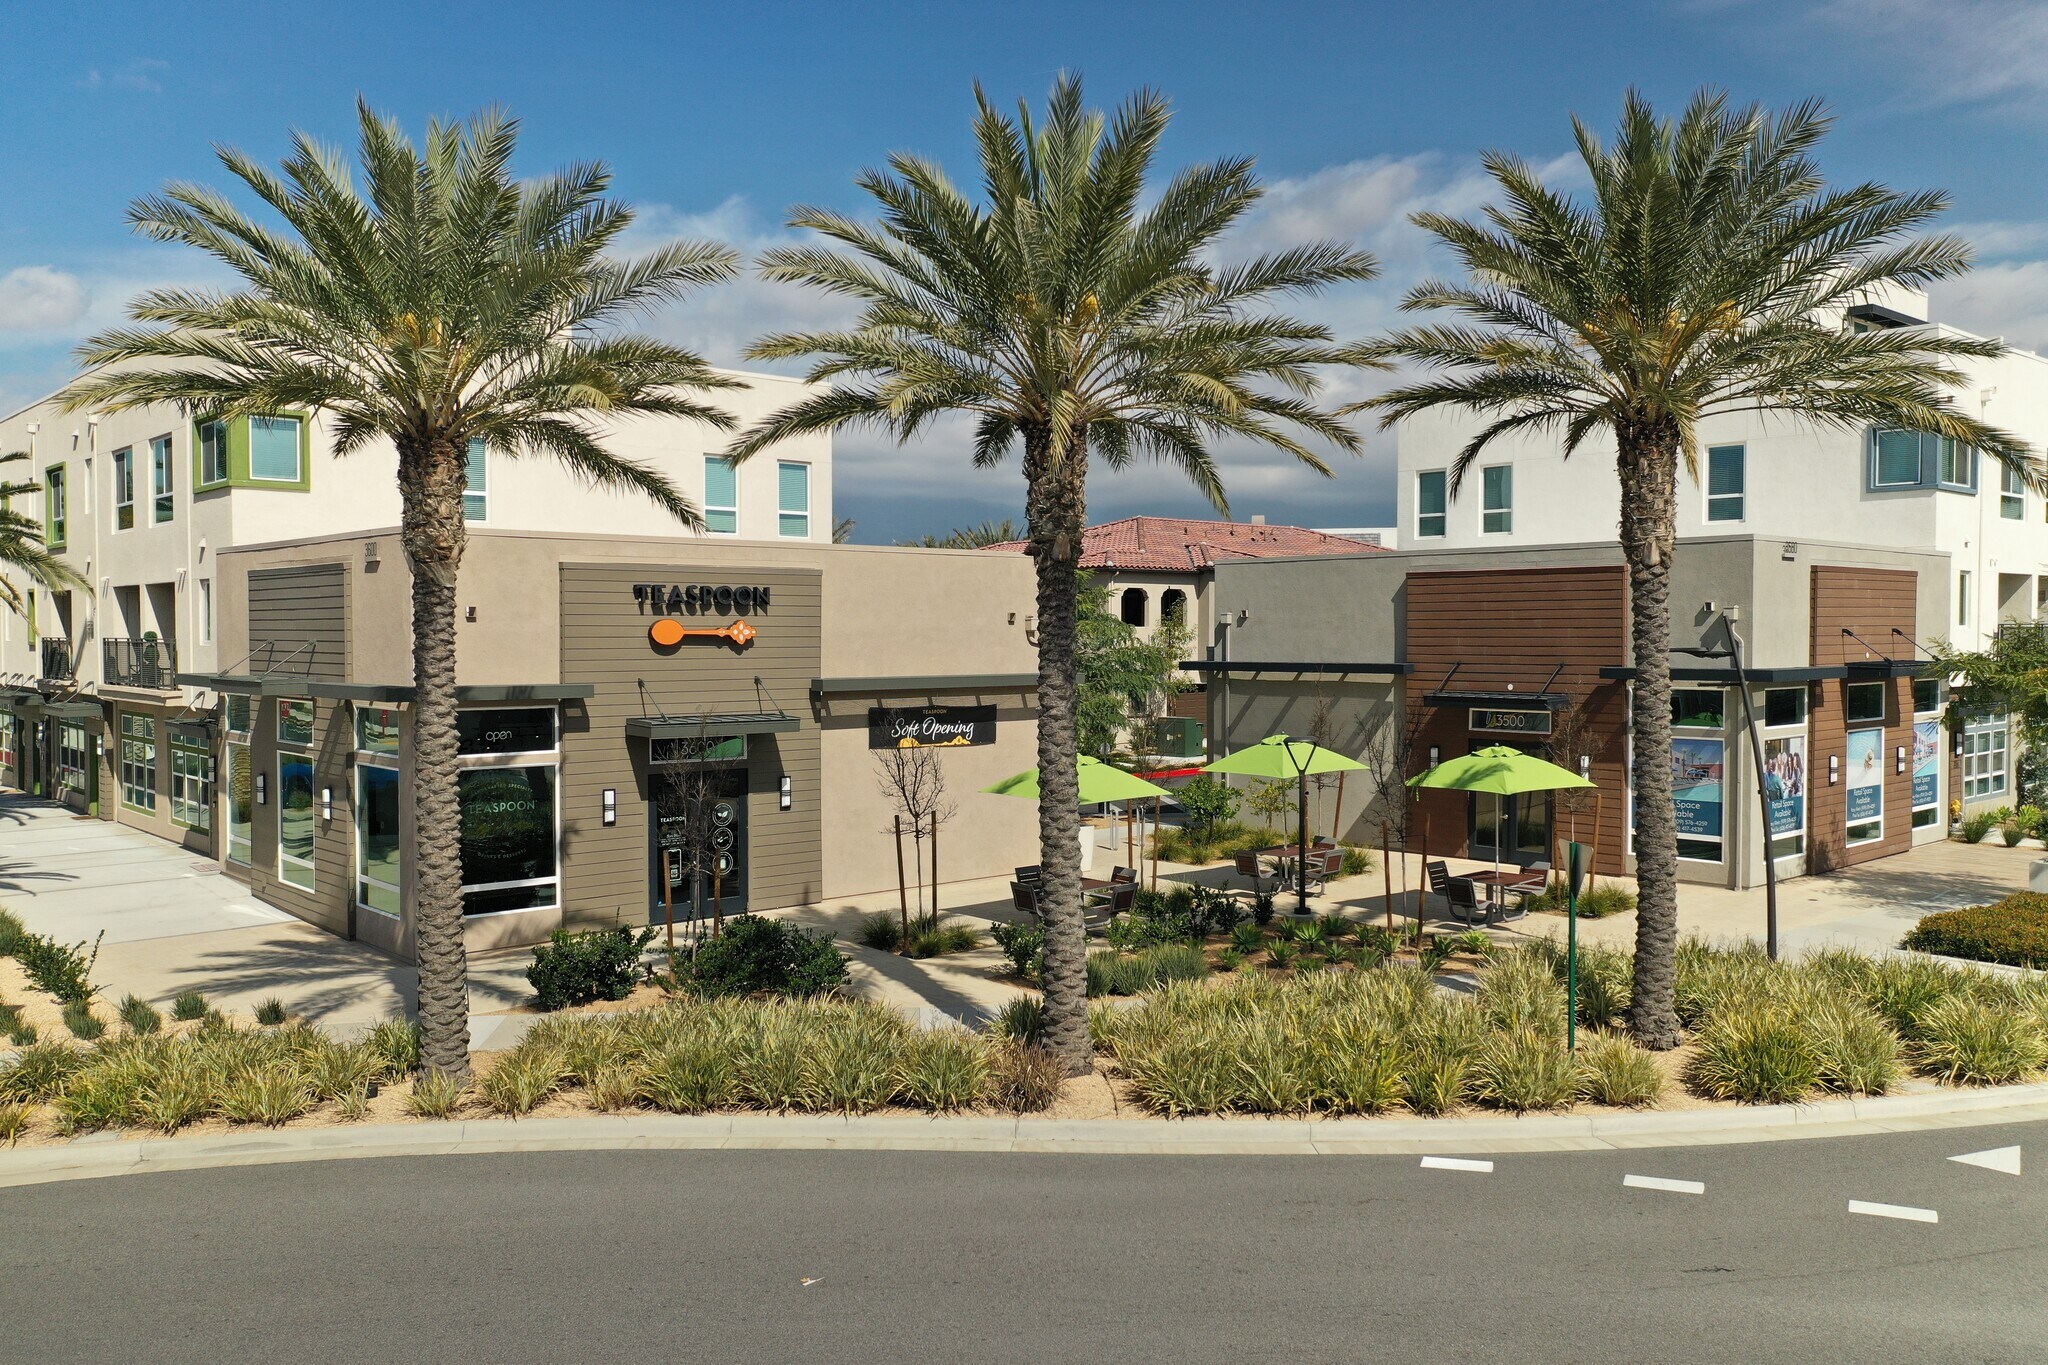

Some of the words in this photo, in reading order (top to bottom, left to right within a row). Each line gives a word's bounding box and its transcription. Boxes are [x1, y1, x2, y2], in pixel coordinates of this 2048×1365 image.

[633, 584, 770, 605] TEASPOON
[1496, 714, 1525, 727] 3500
[891, 717, 919, 739] Soft
[922, 716, 974, 741] Opening
[485, 730, 513, 742] open
[681, 740, 716, 756] 3600
[468, 801, 536, 814] TEASPOON
[1676, 800, 1701, 810] Space
